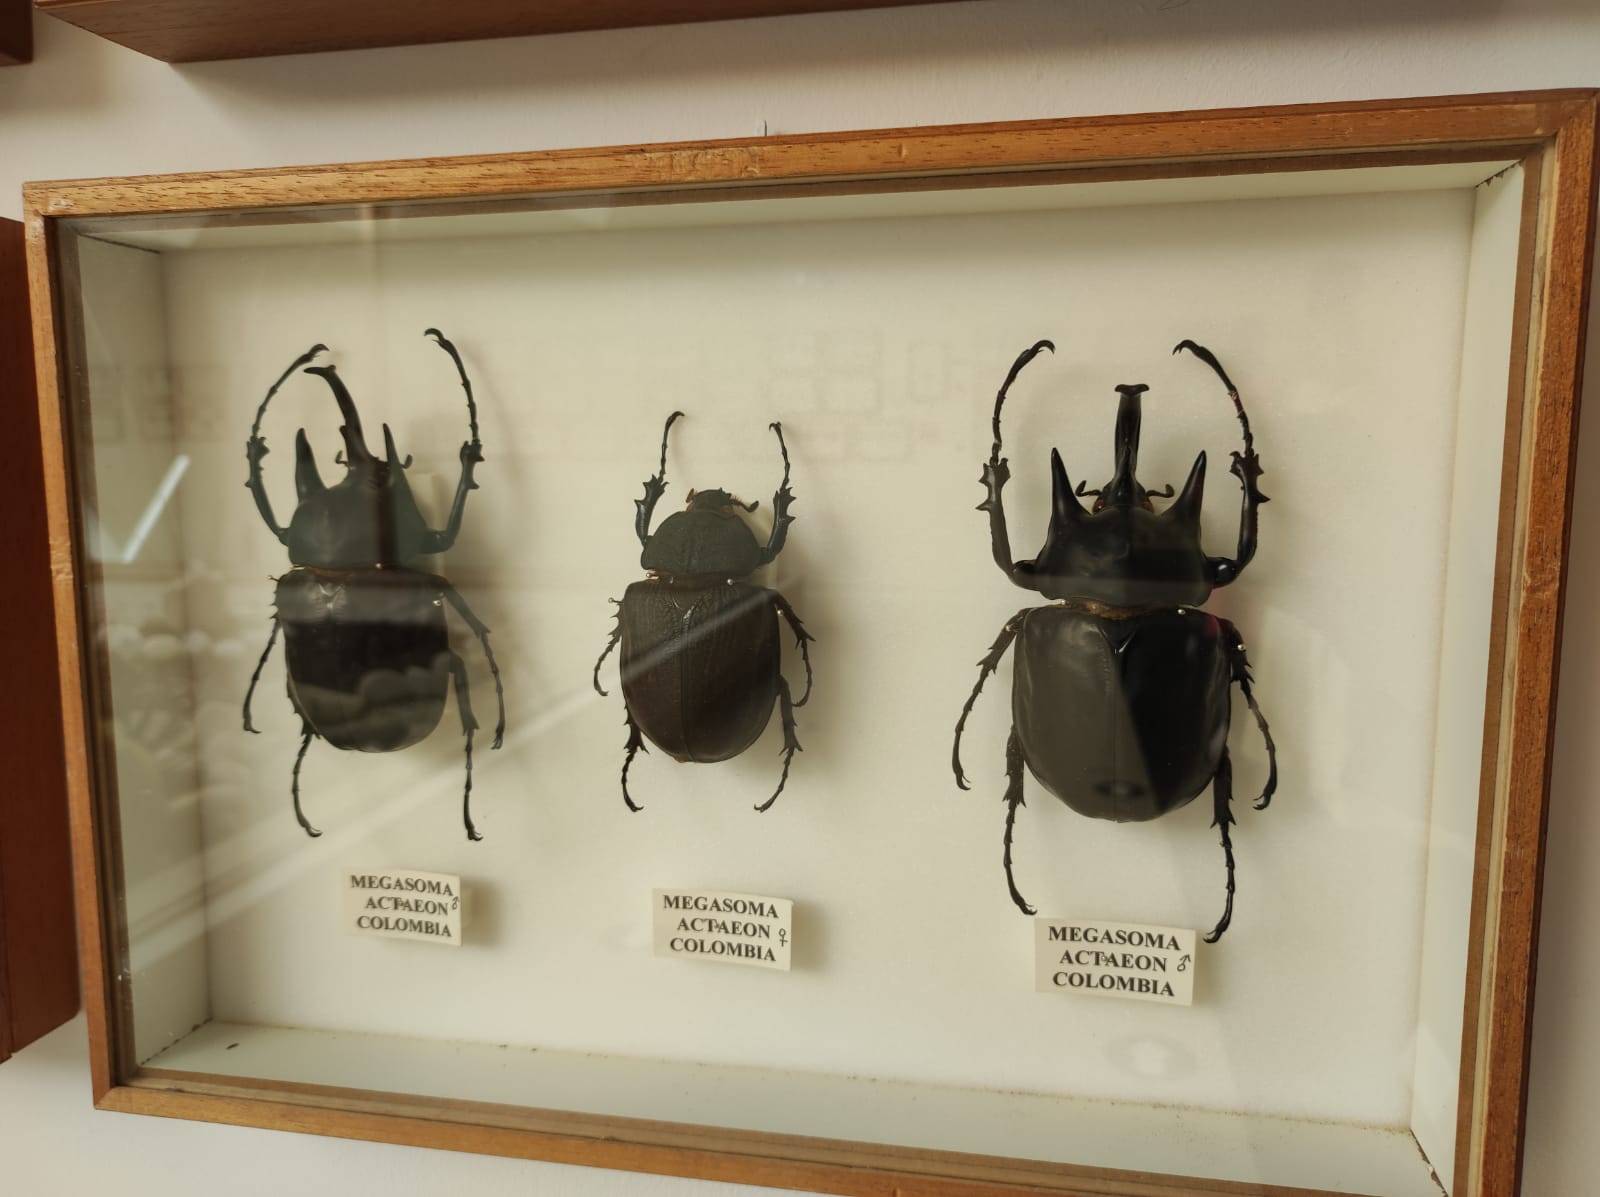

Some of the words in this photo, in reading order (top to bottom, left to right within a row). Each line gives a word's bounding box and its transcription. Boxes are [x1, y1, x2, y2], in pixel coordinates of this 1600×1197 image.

[351, 875, 454, 897] MEGASOMA
[365, 897, 449, 915] ACTAEON
[664, 895, 779, 919] MEGASOMA
[357, 916, 452, 937] COLOMBIA
[677, 917, 771, 939] ACTAEON
[1048, 926, 1181, 951] MEGASOMA
[670, 938, 776, 962] COLOMBIA
[1059, 950, 1167, 972] ACTAEON
[1052, 972, 1175, 997] COLOMBIA
